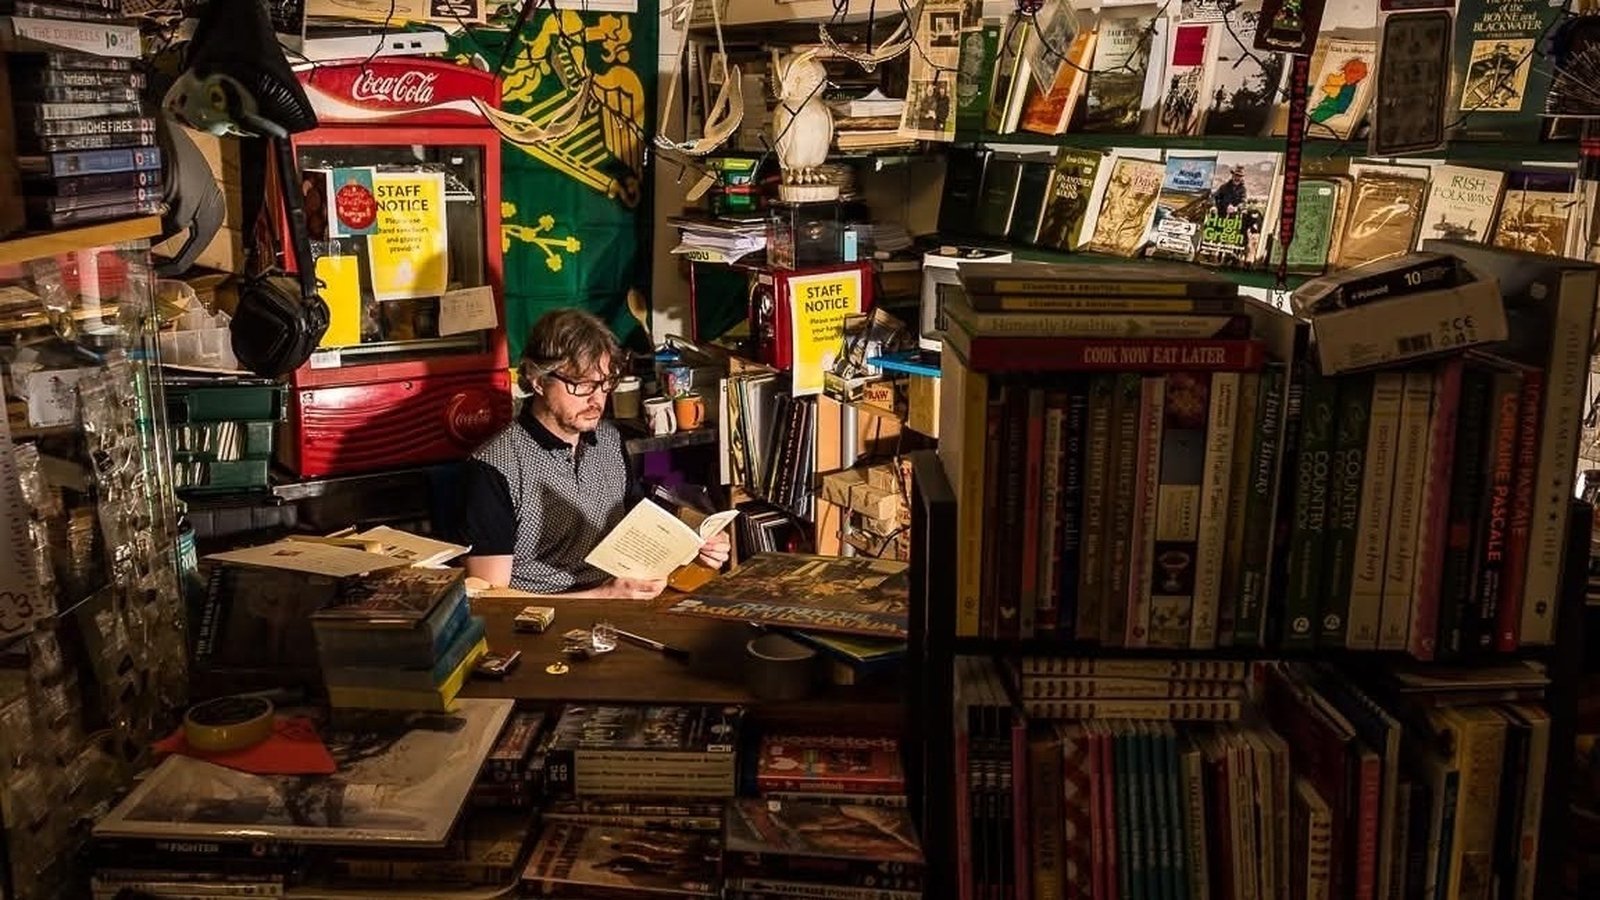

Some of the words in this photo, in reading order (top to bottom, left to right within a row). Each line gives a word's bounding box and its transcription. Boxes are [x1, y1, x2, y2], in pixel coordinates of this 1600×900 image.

[1483, 12, 1519, 21] BOYNE
[1520, 11, 1537, 20] and
[1473, 20, 1542, 32] BLACKWATER
[352, 69, 440, 103] Coca-Cola
[377, 185, 421, 197] STAFF
[1451, 175, 1487, 191] IRISH
[376, 199, 429, 211] NOTICE
[1204, 214, 1242, 231] Hugh
[1203, 227, 1244, 244] Green
[1403, 271, 1421, 286] 10
[806, 284, 843, 298] STAFF
[805, 296, 849, 313] NOTICE
[1082, 346, 1118, 364] COOK
[1120, 346, 1150, 364] NOW
[1152, 346, 1180, 364] EAT
[1181, 346, 1226, 364] LATER
[868, 389, 889, 400] RAW
[1521, 382, 1541, 464] LORRAINE
[1495, 391, 1518, 483] LORRAINE
[1308, 450, 1330, 533] COUNTRY
[1341, 447, 1361, 531] COUNTRY
[1511, 467, 1536, 537] PASCALE
[1486, 485, 1509, 562] PASCALE
[169, 843, 219, 854] FIGHTER
